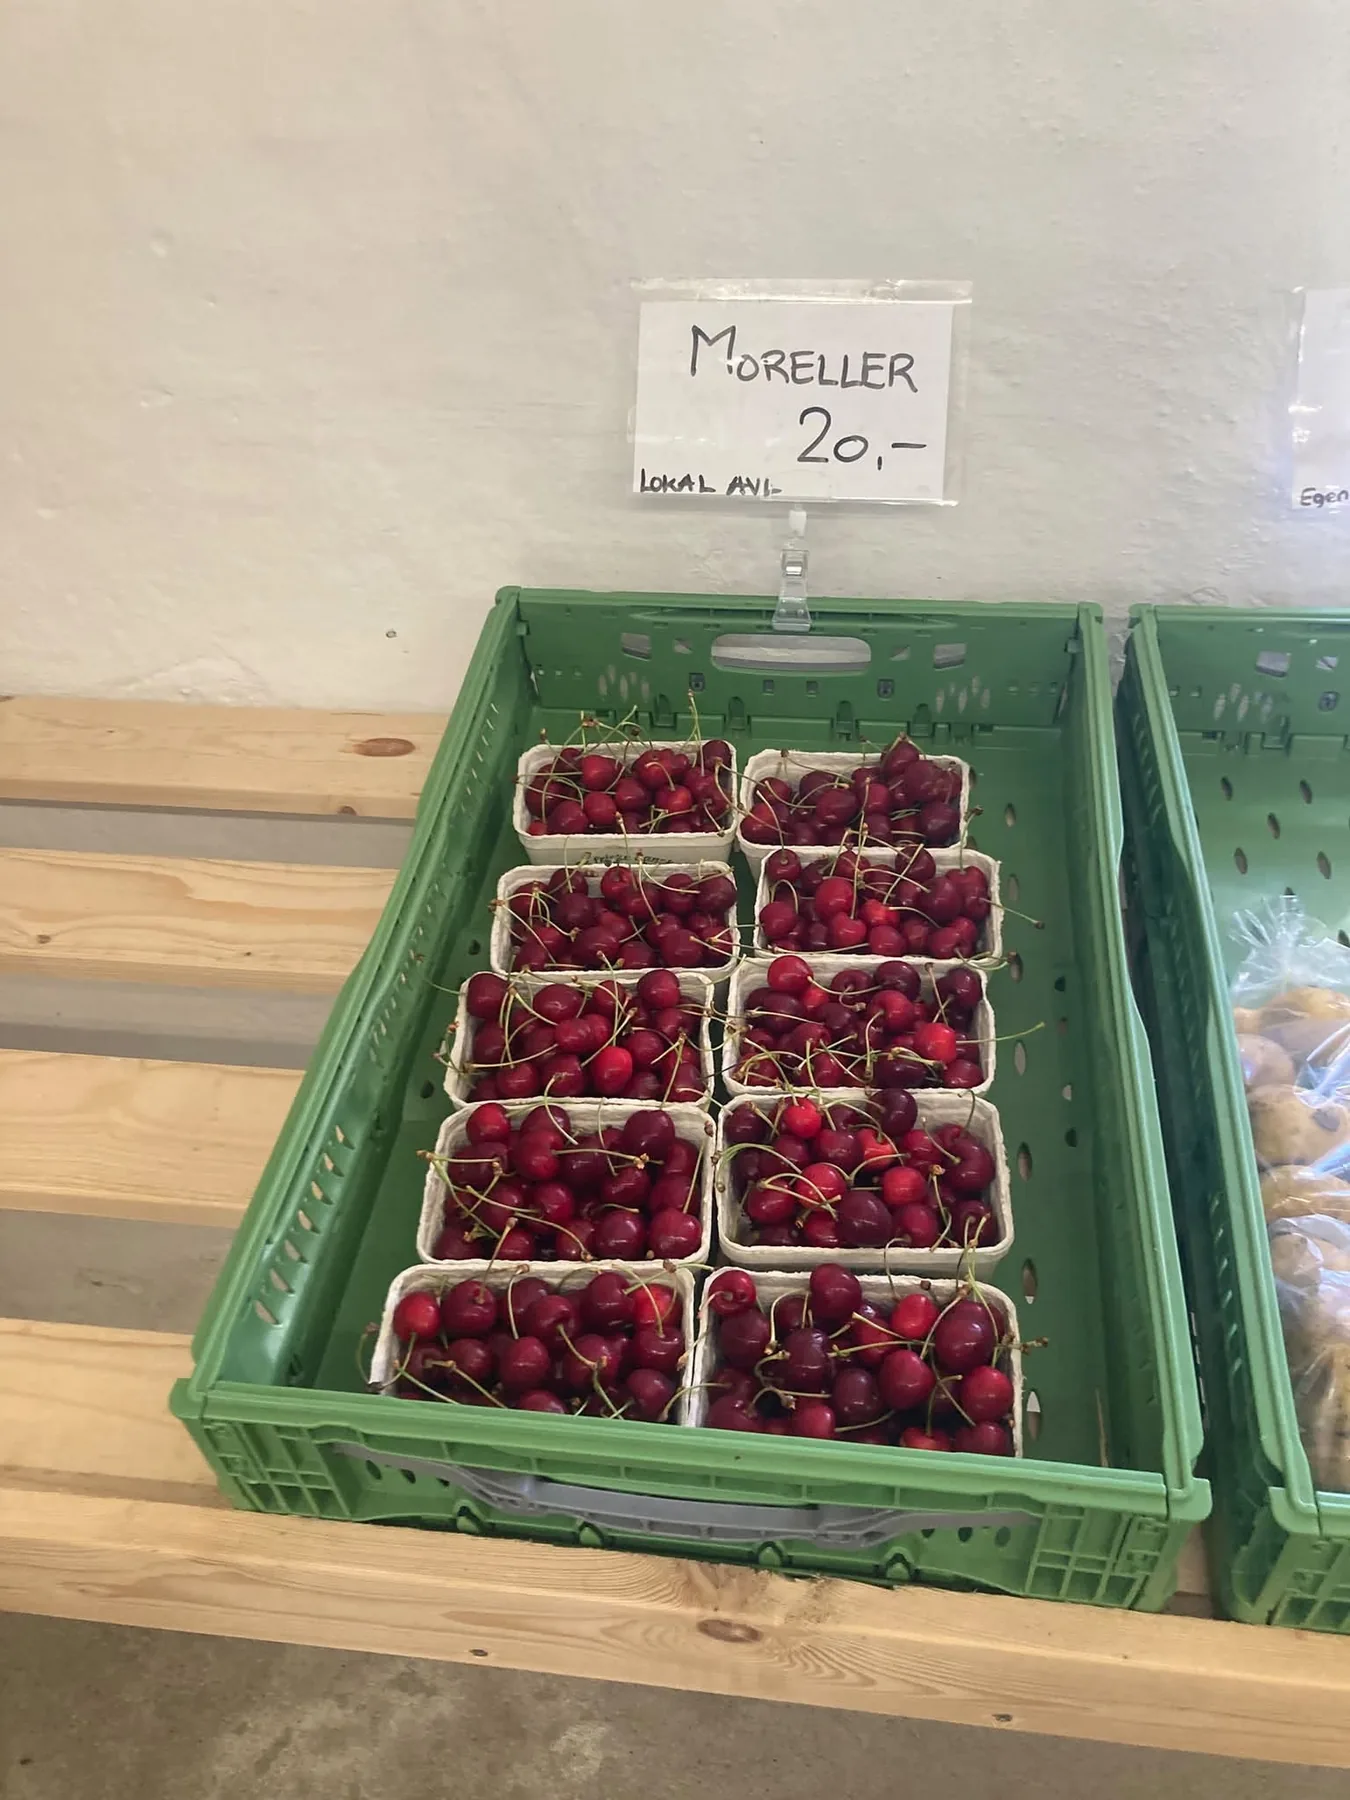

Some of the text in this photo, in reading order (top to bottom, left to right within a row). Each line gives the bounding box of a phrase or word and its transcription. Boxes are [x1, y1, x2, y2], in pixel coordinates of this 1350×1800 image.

[690, 324, 918, 393] MORELLER
[797, 406, 927, 471] 20,-
[640, 468, 716, 493] LOKAL
[1300, 487, 1349, 508] Egen
